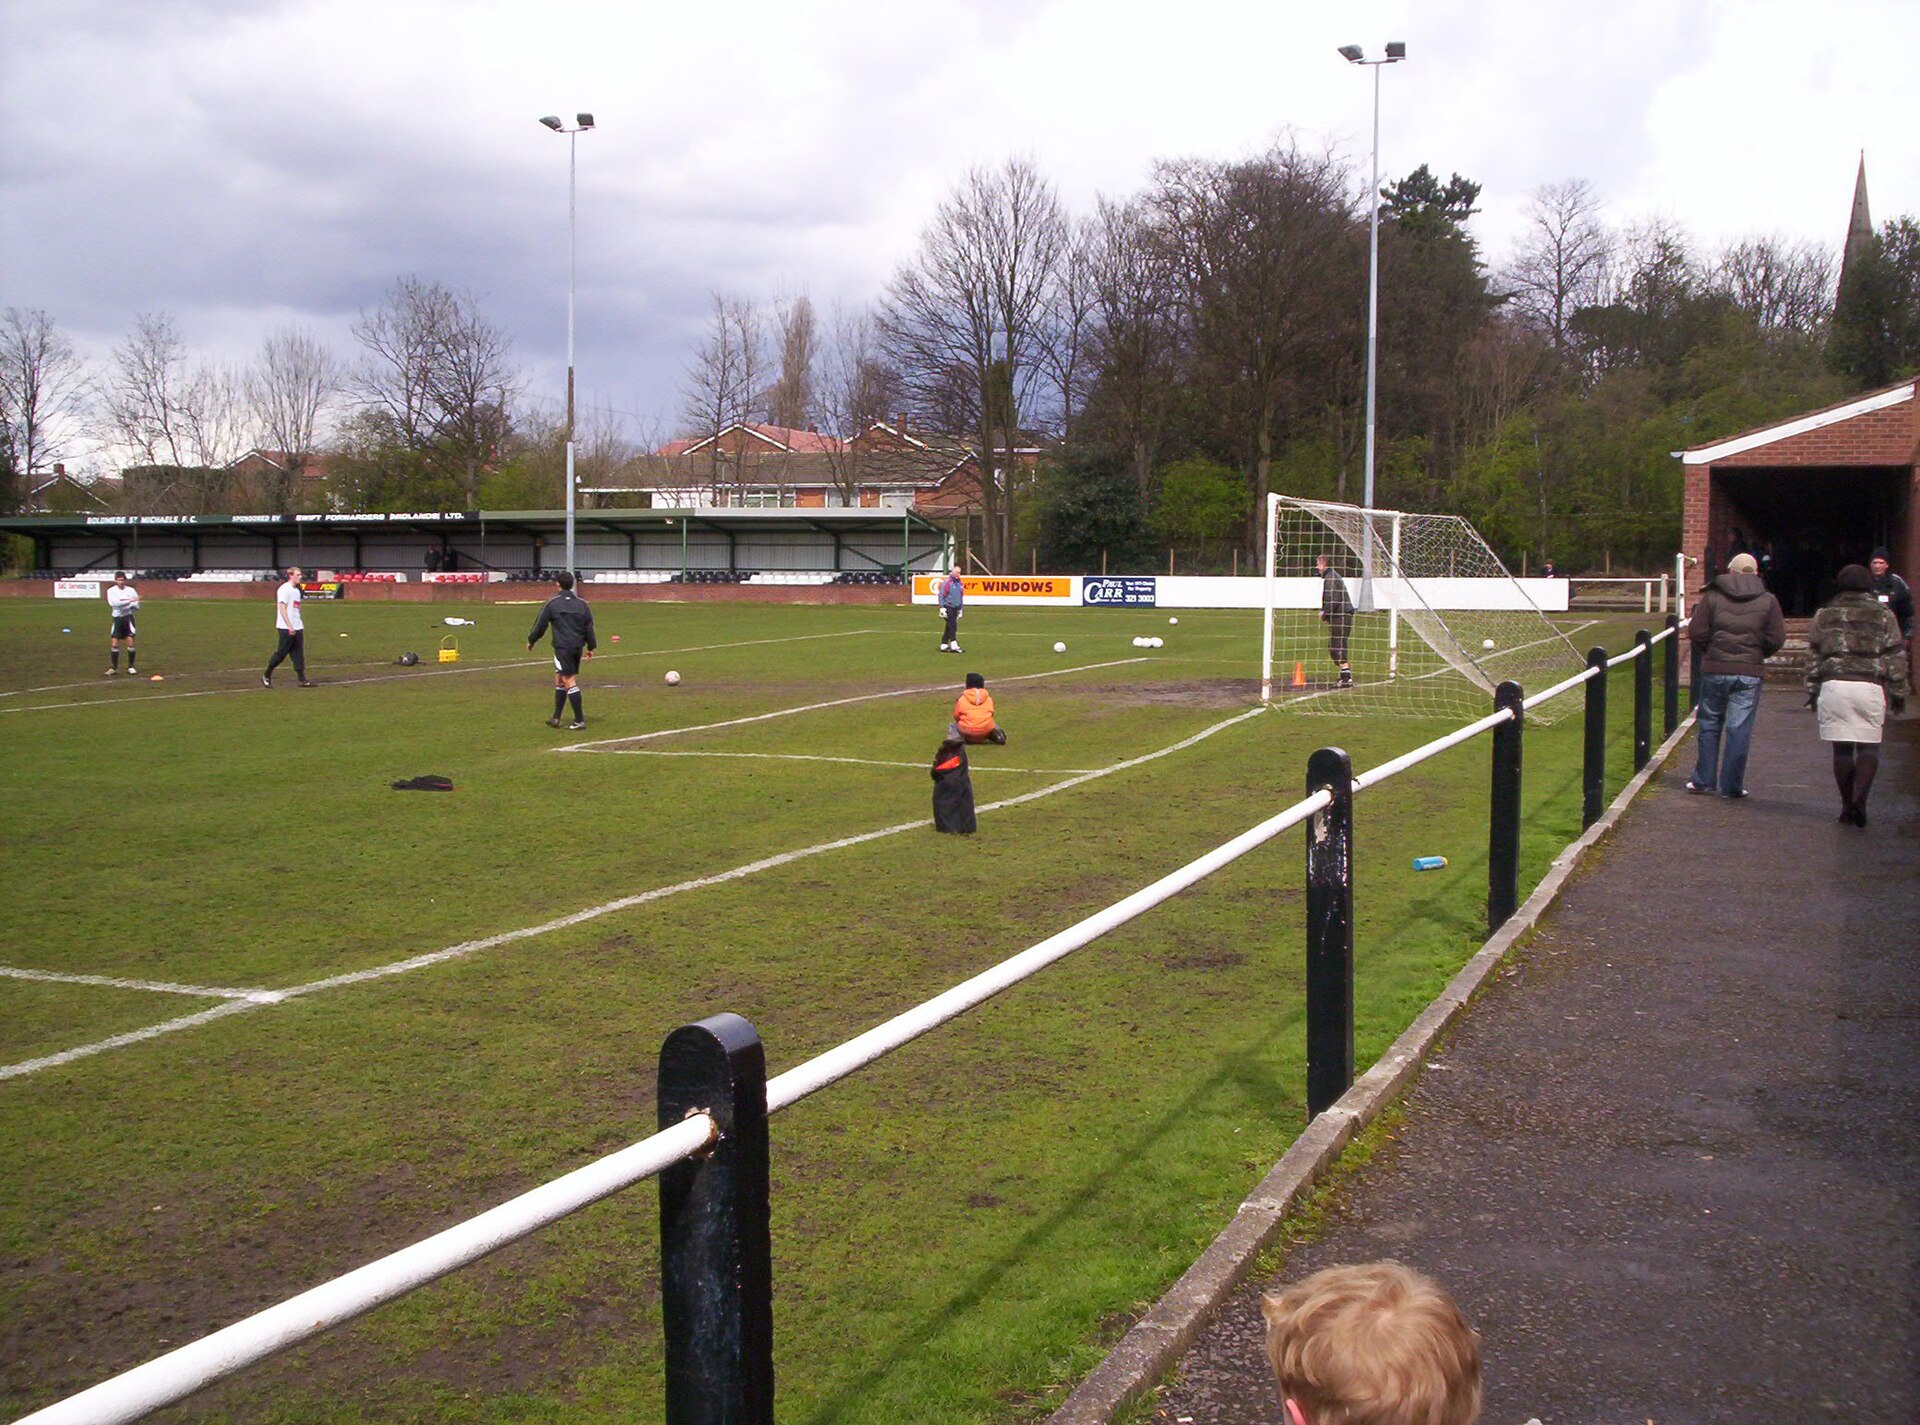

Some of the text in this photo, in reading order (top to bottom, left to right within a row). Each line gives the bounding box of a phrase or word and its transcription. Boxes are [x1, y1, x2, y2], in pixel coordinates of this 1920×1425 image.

[141, 516, 178, 524] MICHAELS
[982, 581, 1053, 593] WINDOWS
[1102, 579, 1123, 588] PAUL
[1084, 582, 1123, 603] CARR
